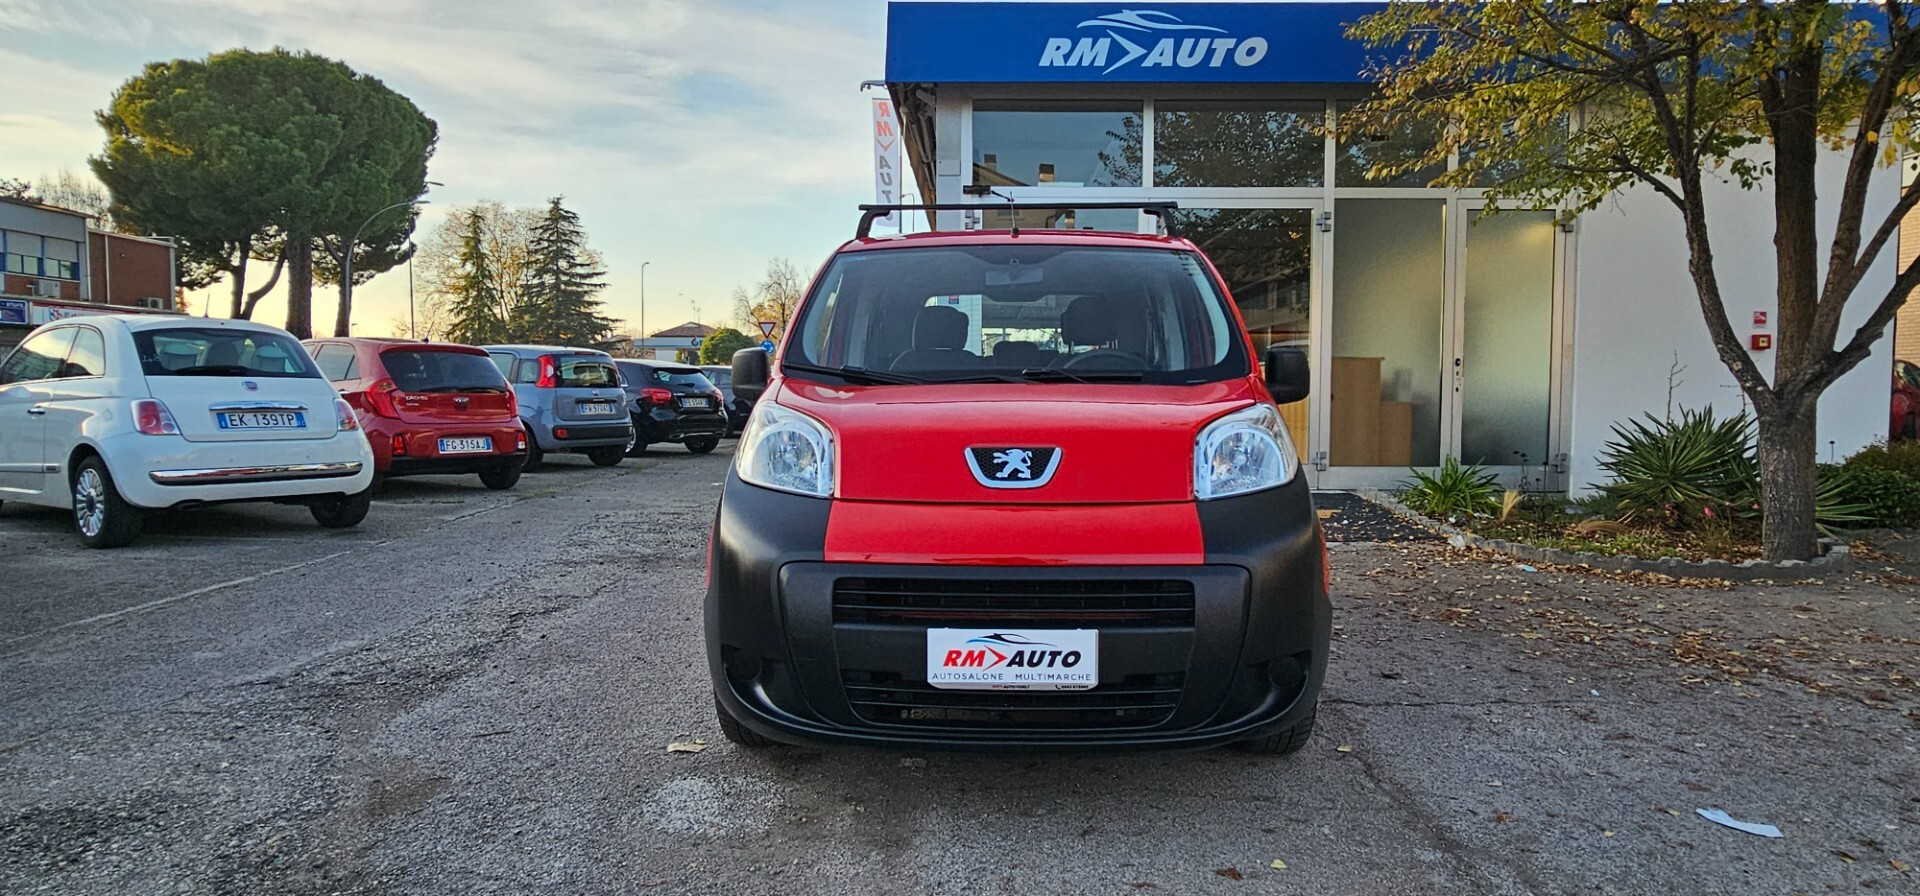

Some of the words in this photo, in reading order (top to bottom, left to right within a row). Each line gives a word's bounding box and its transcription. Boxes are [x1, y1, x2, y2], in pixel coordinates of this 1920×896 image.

[1141, 37, 1269, 67] AUTO
[228, 414, 248, 427] EK
[253, 413, 295, 426] 139TP
[445, 440, 457, 450] FG
[460, 439, 486, 450] 315AJ
[1006, 650, 1082, 668] AUTO
[932, 672, 1004, 681] AUTOSALONE
[1015, 673, 1092, 681] MULTIMARCHE
